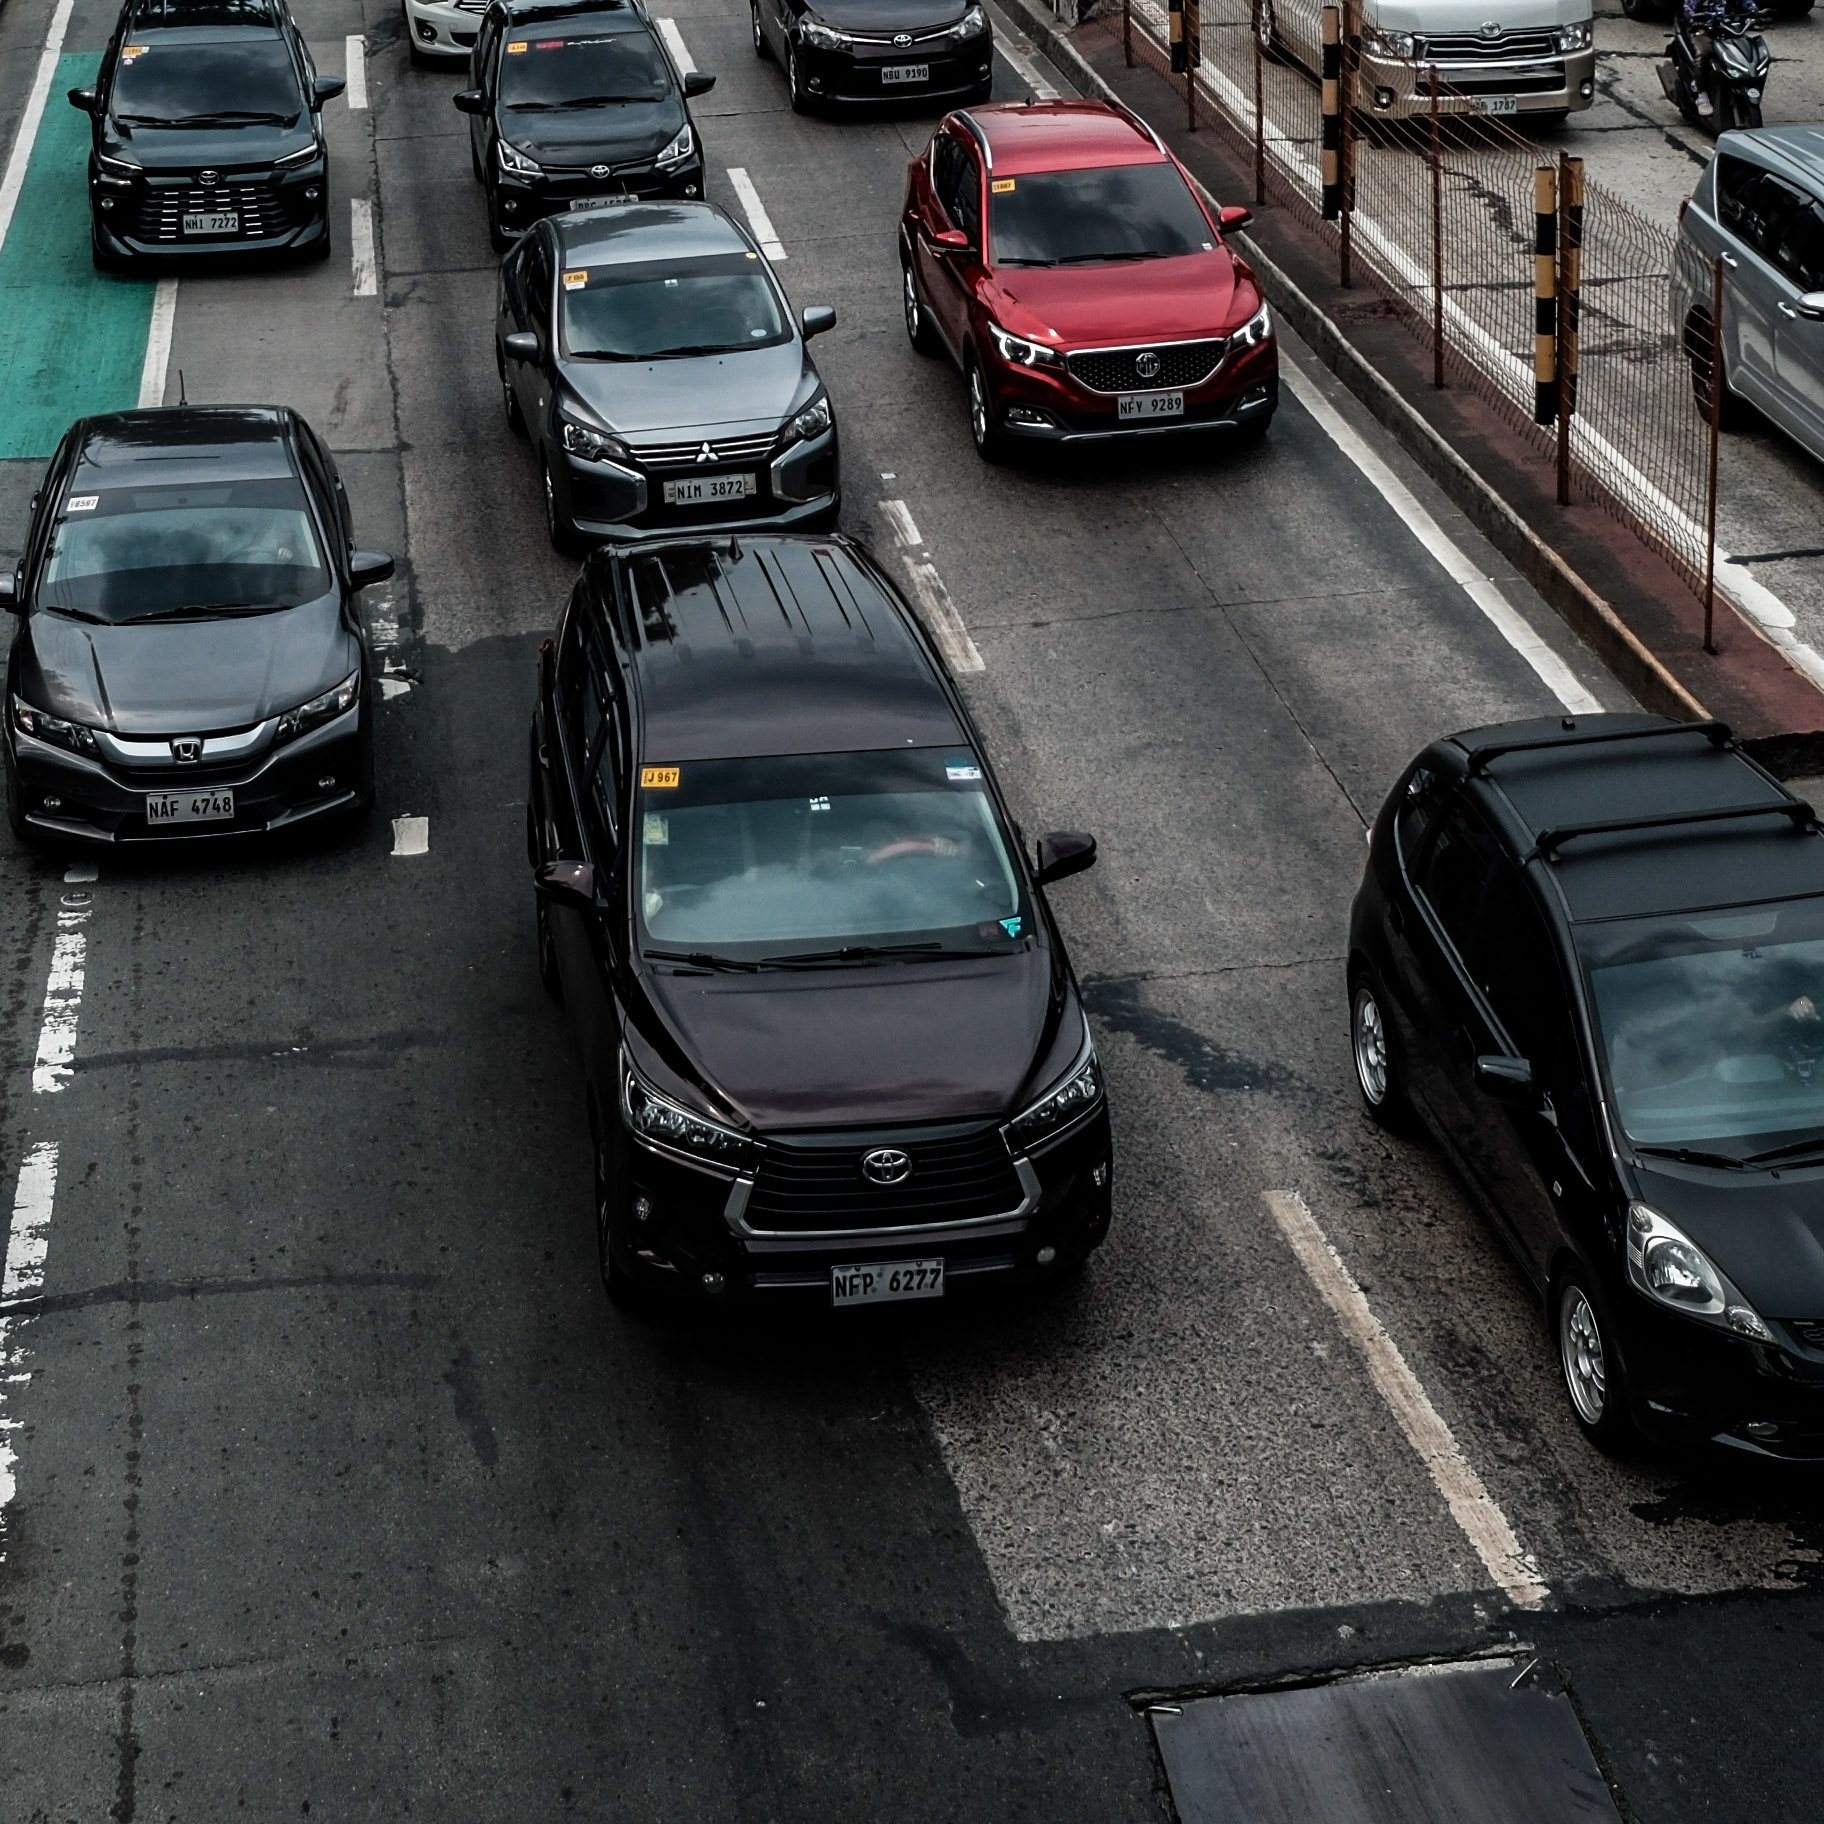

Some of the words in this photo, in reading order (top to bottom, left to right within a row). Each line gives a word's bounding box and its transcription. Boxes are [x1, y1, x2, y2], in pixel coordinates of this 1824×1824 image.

[185, 217, 207, 230] NHI
[211, 217, 237, 229] 7272
[1151, 397, 1182, 412] 9289
[677, 486, 702, 499] NIM
[710, 481, 743, 496] 3872
[658, 772, 676, 783] 967
[148, 800, 179, 819] NAF
[192, 796, 232, 815] 4748
[835, 1272, 874, 1297] NFP
[889, 1268, 941, 1293] 6277
